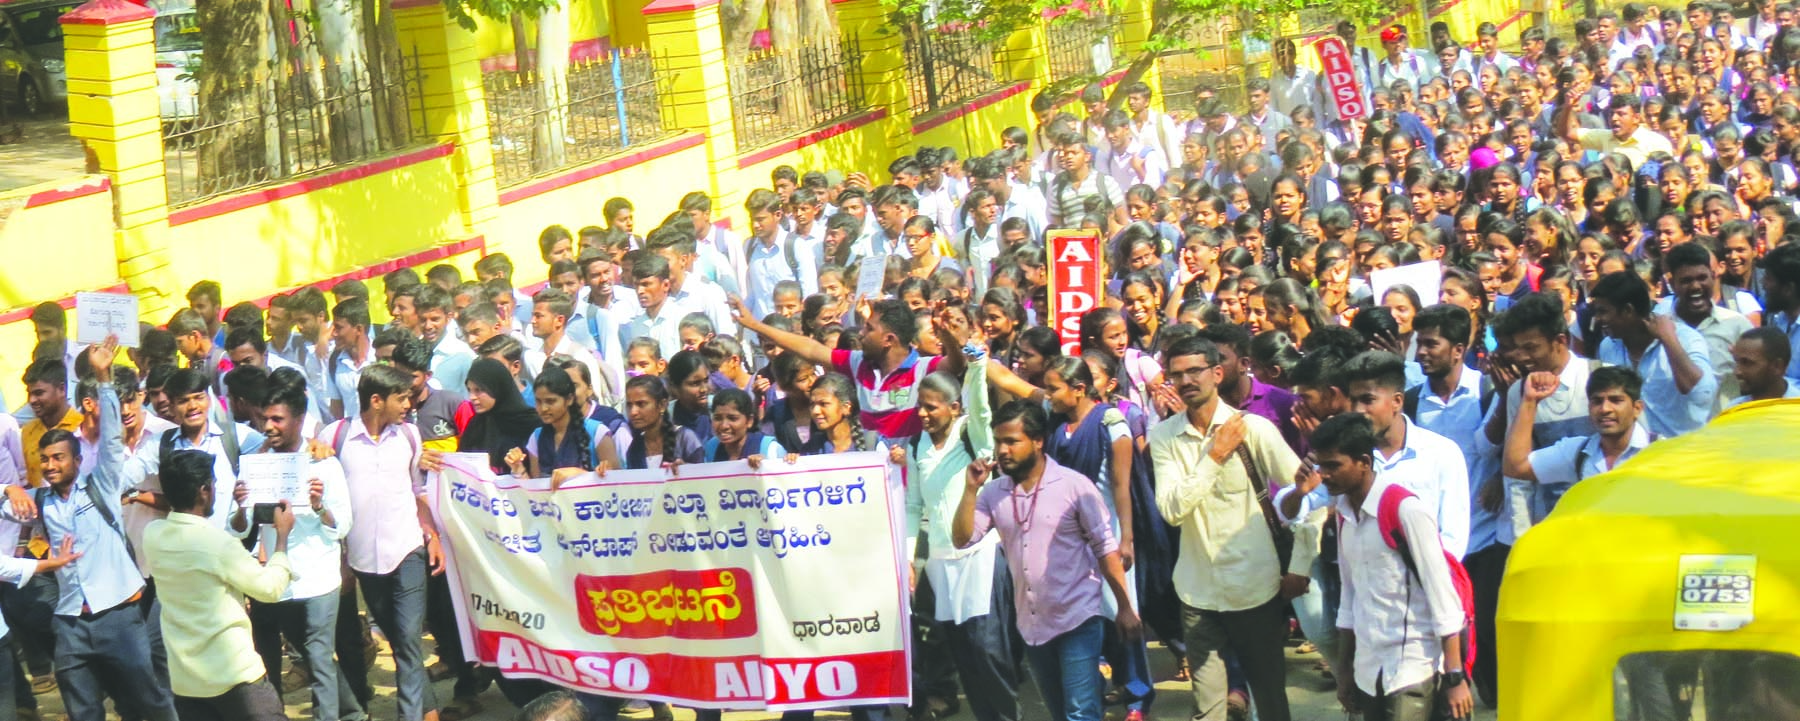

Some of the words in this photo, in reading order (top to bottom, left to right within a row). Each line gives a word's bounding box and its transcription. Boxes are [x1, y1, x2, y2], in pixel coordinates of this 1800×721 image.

[1323, 42, 1361, 116] AIDSO
[663, 491, 709, 521] ಎಲ್ಲಾ
[719, 477, 866, 523] ವಿದ್ಯಾರ್ಥಿಗಳಿಗೆ
[649, 521, 748, 553] ನೀಡುವಂತೆ
[1683, 588, 1751, 603] 0753
[1684, 575, 1750, 589] DTPS
[587, 571, 742, 635] ಪ್ರತಿಭಟನೆ
[793, 611, 881, 640] ಧಾರವಾಡ
[497, 636, 650, 692] AIDSO
